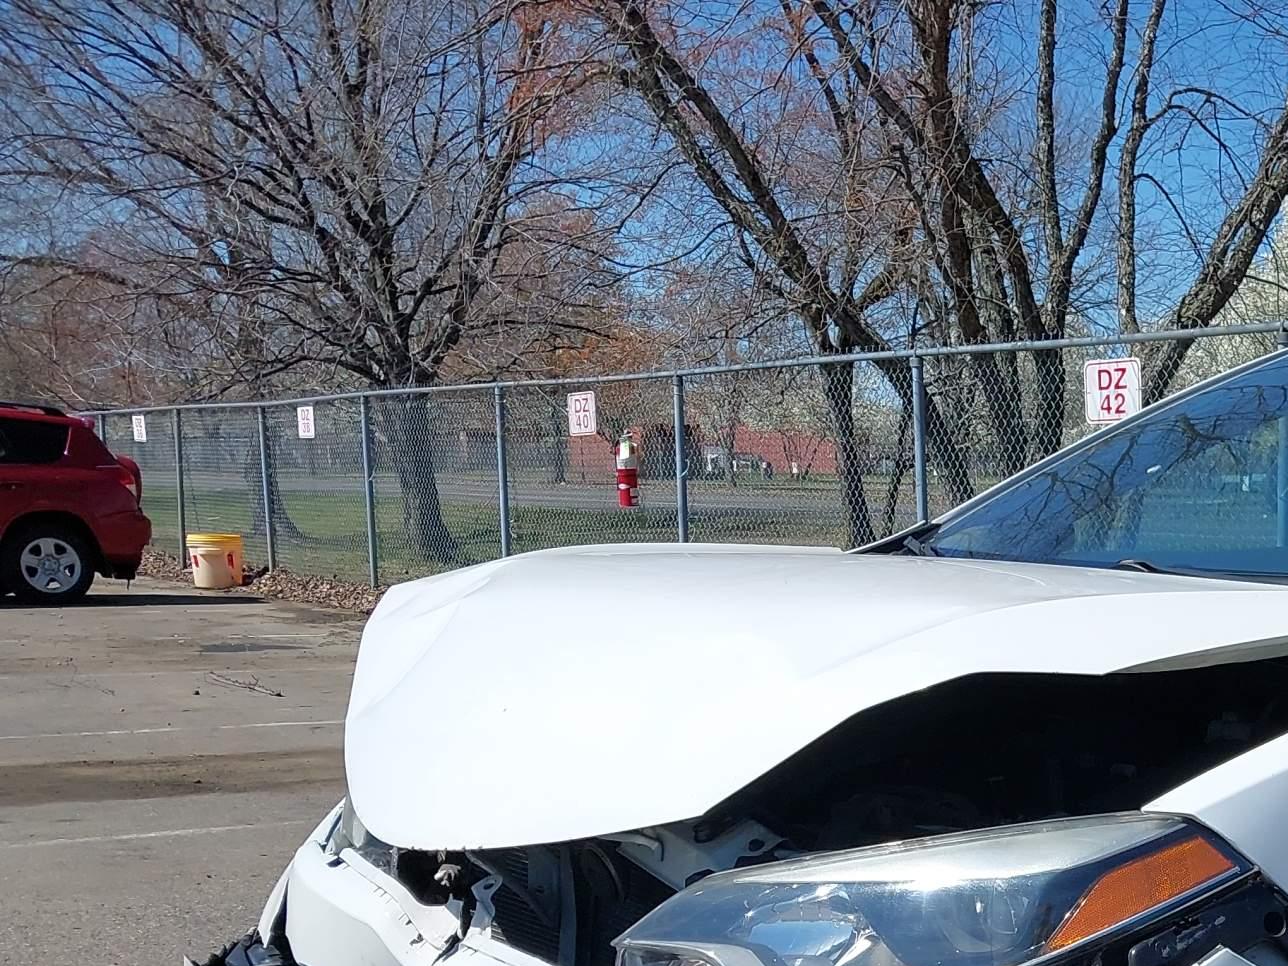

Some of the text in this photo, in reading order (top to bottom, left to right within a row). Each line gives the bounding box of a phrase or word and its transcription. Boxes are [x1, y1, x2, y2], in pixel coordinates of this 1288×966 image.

[1097, 368, 1127, 390] DZ
[574, 398, 589, 413] DZ
[1100, 393, 1126, 414] 42
[575, 414, 589, 429] 40
